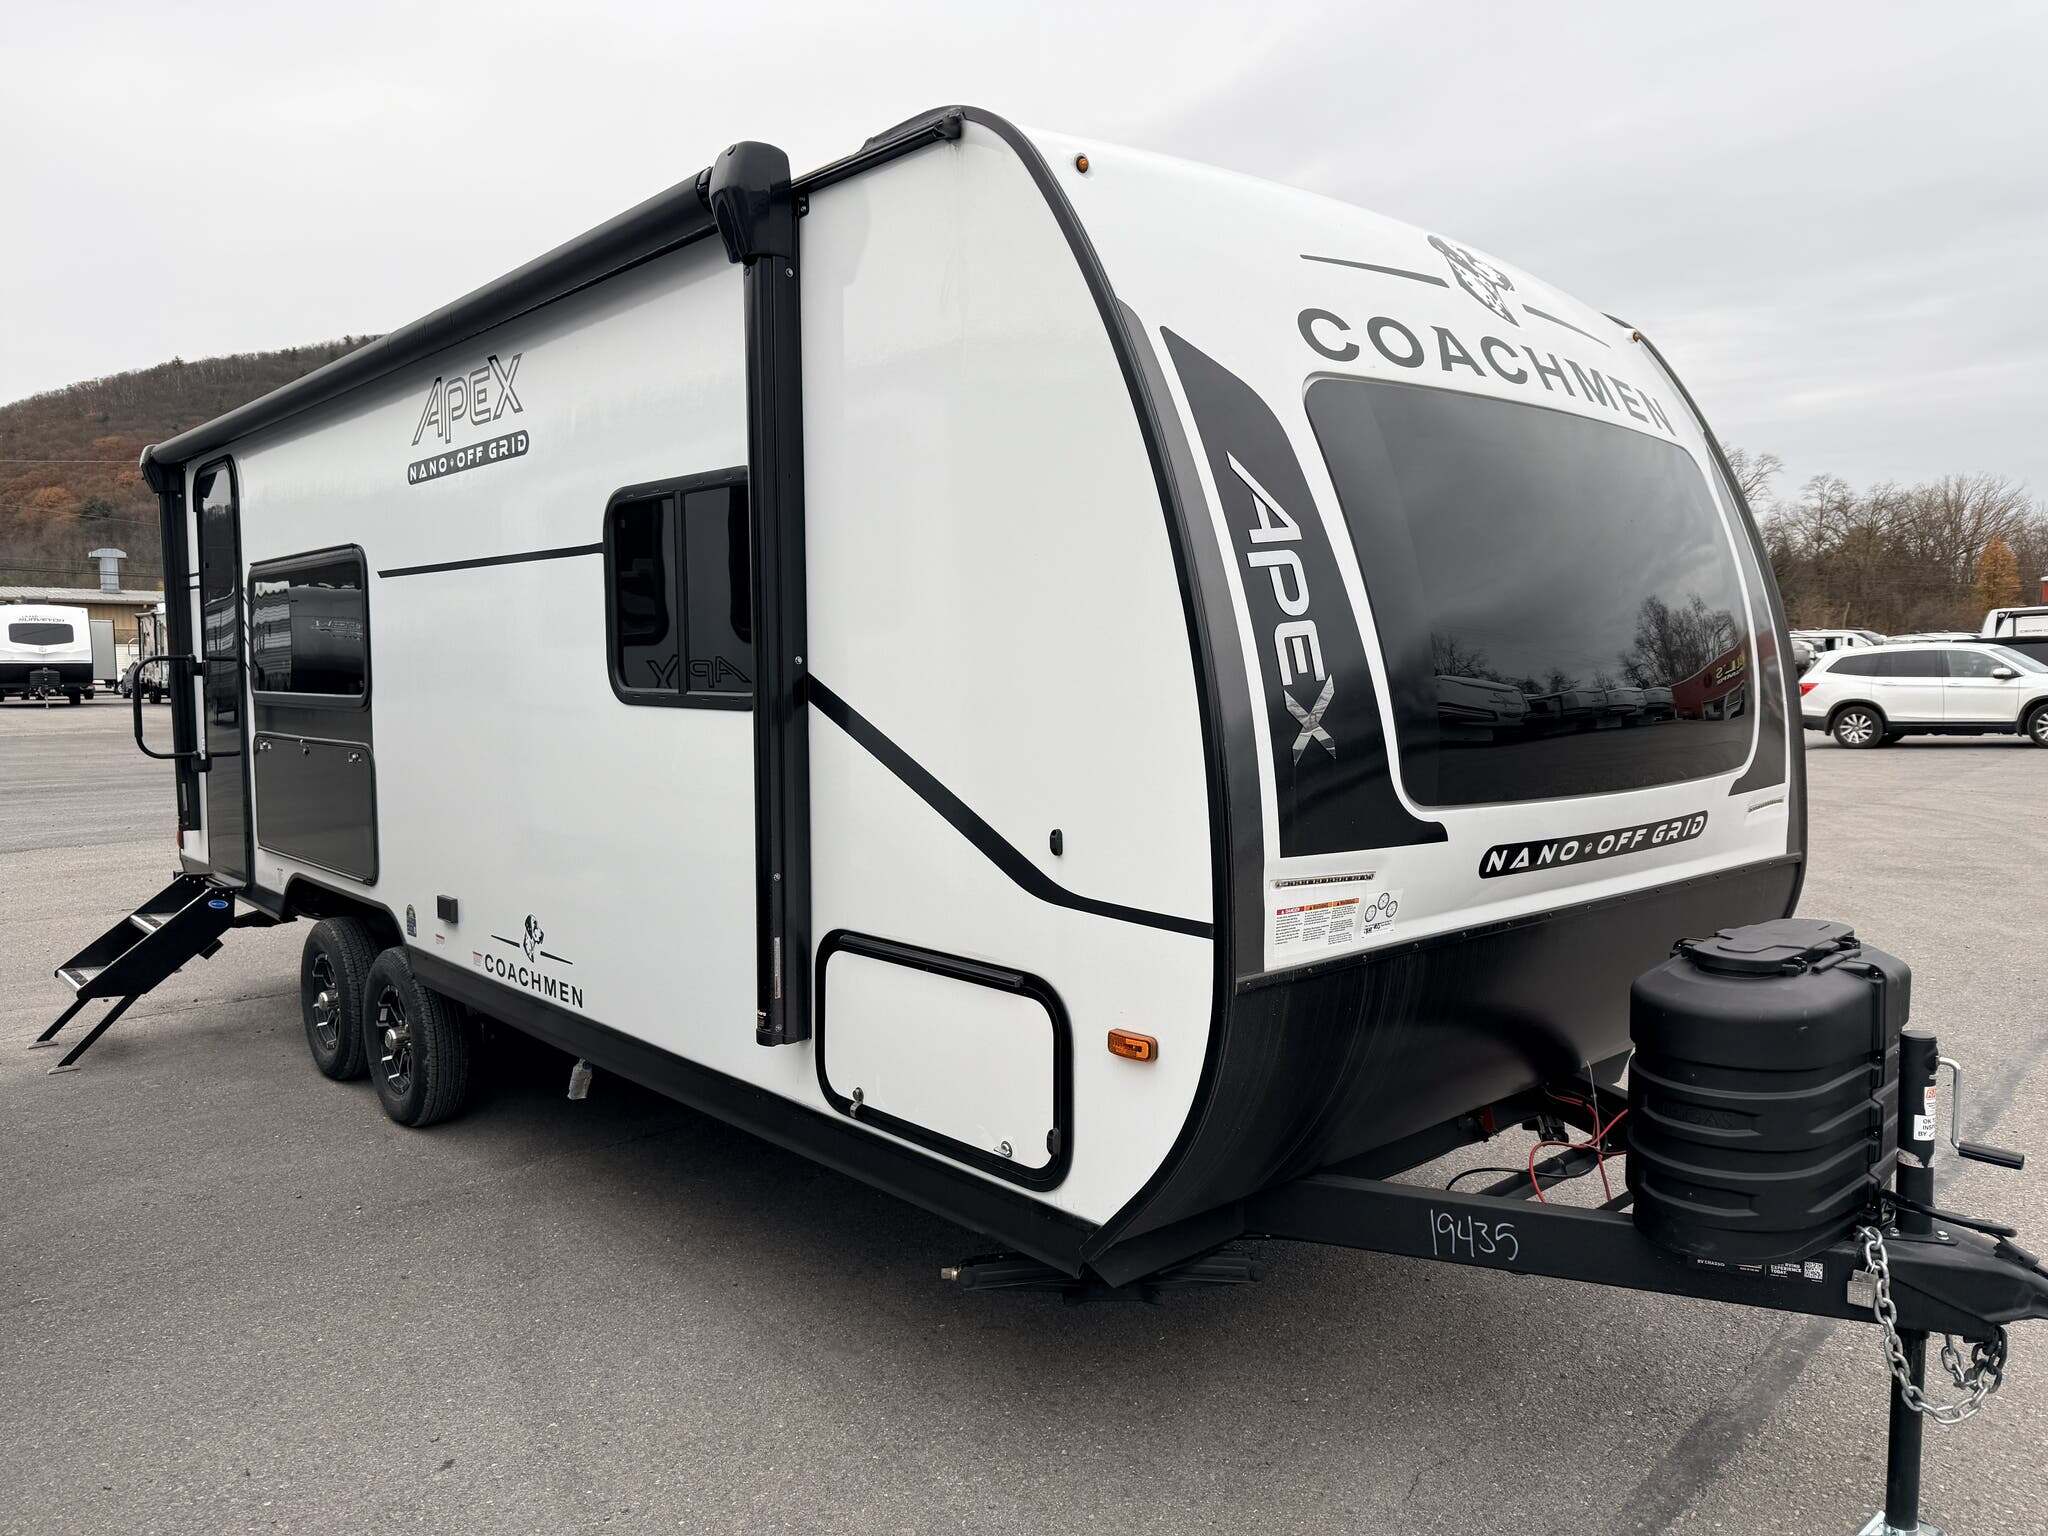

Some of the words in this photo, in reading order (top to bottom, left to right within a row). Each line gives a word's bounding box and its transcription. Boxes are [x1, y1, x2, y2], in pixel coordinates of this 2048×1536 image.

[411, 352, 524, 447] APEX
[1297, 308, 1677, 437] COACHMEN
[409, 457, 448, 482] NANO
[456, 446, 484, 468] OFF
[488, 434, 527, 460] GRID
[1226, 450, 1337, 767] APEX
[1485, 840, 1580, 873] NANO
[1597, 828, 1648, 855] OFF
[1651, 815, 1705, 844] GRID
[484, 953, 583, 1009] COACHMEN
[1430, 1208, 1519, 1261] 19435
